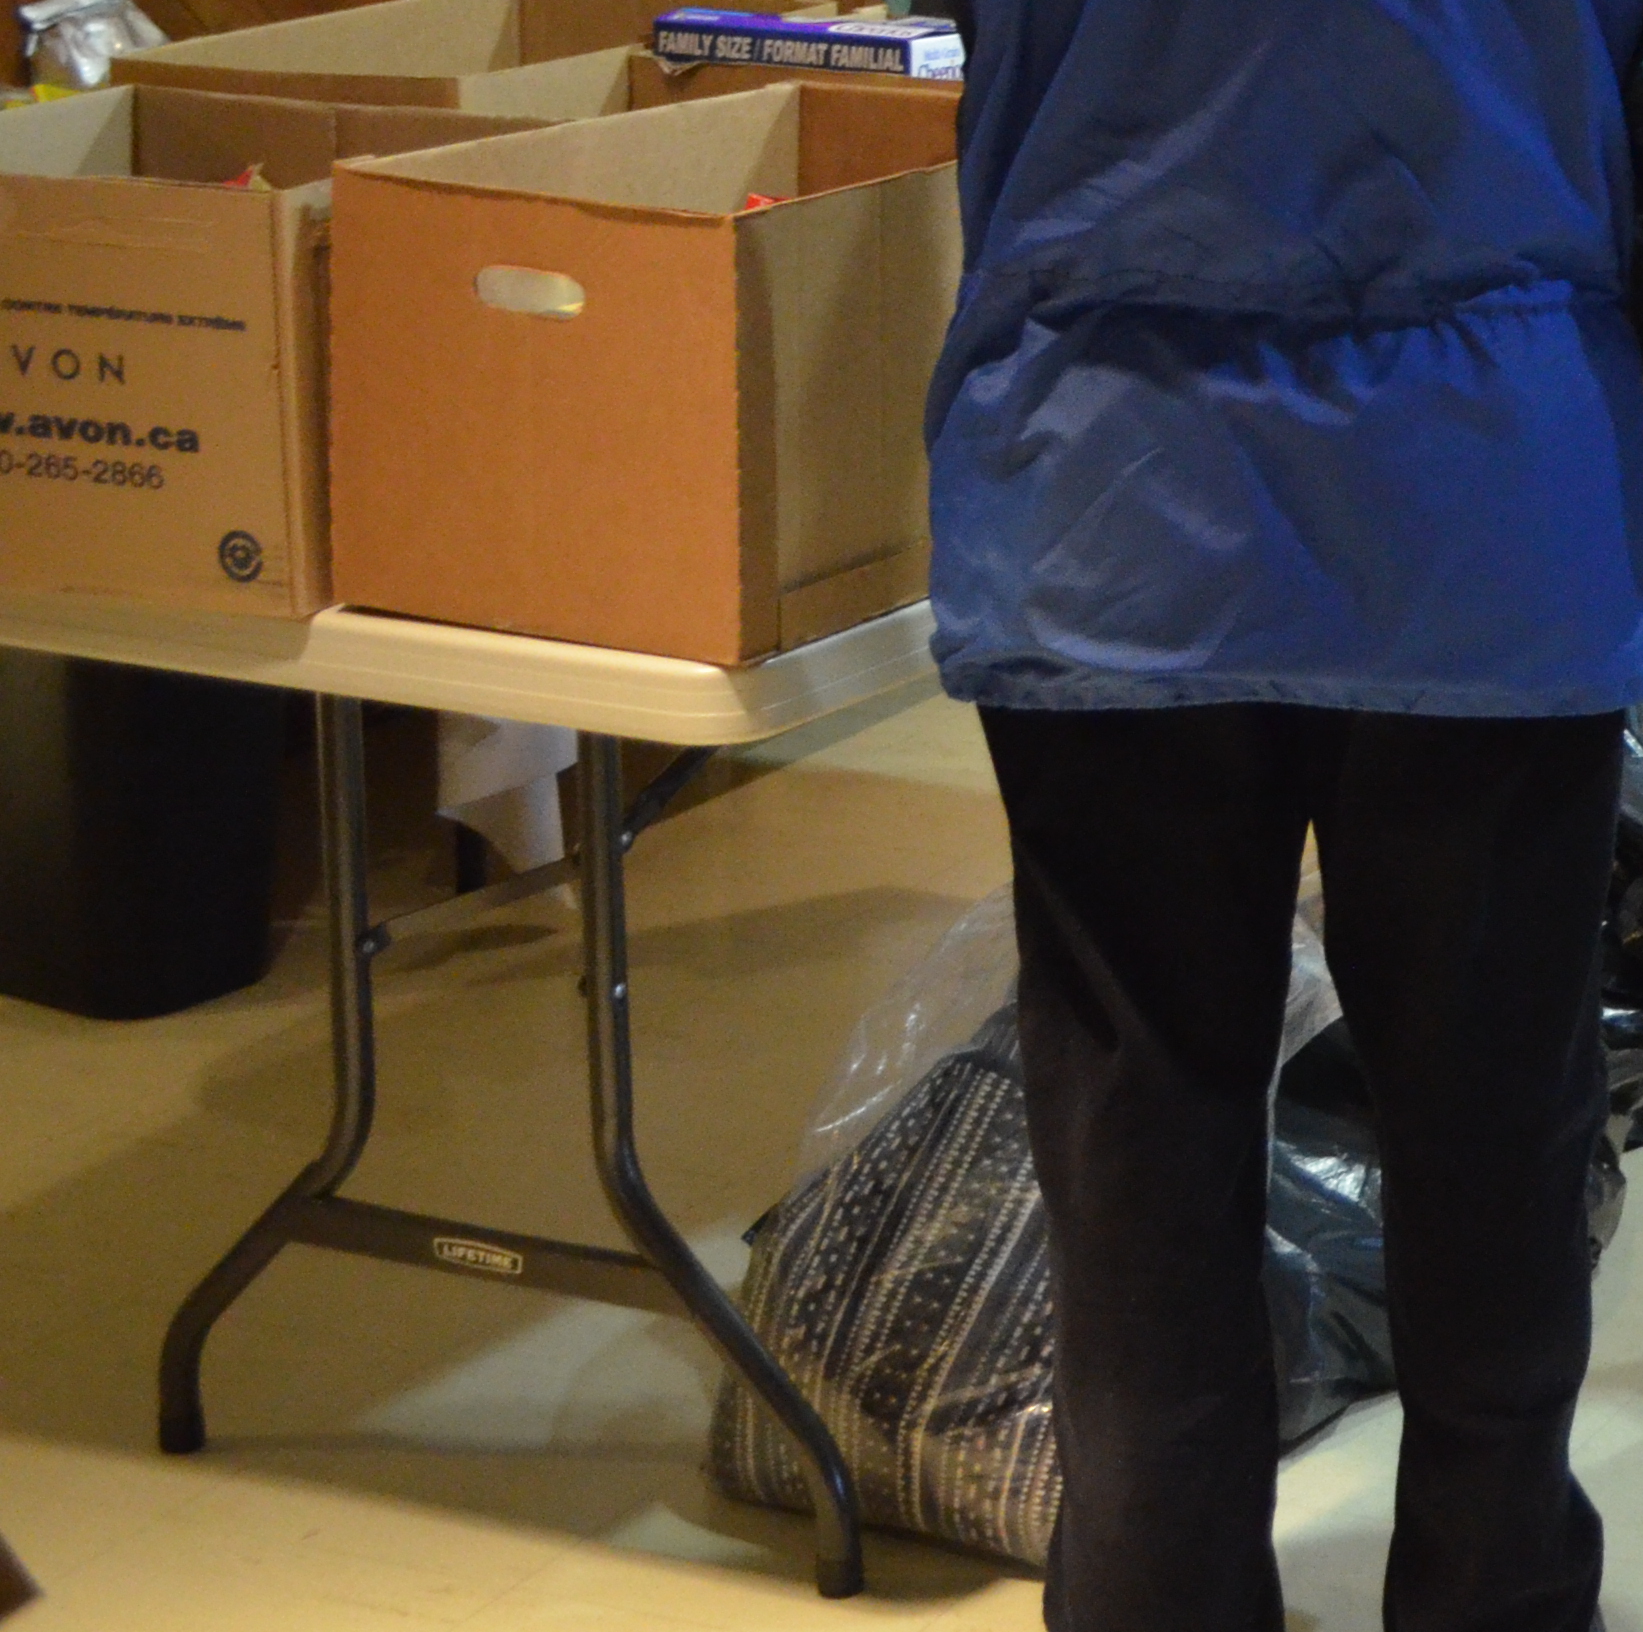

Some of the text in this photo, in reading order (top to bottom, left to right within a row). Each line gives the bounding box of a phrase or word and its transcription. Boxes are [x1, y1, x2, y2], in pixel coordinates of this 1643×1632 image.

[657, 30, 713, 57] FAMILY
[715, 34, 752, 60] SIZE
[762, 39, 828, 66] FORMAT
[830, 42, 904, 73] FAMILIAL
[11, 343, 126, 385] VON
[0, 448, 166, 490] 0-265-2866
[442, 1243, 512, 1270] LIFETIME
